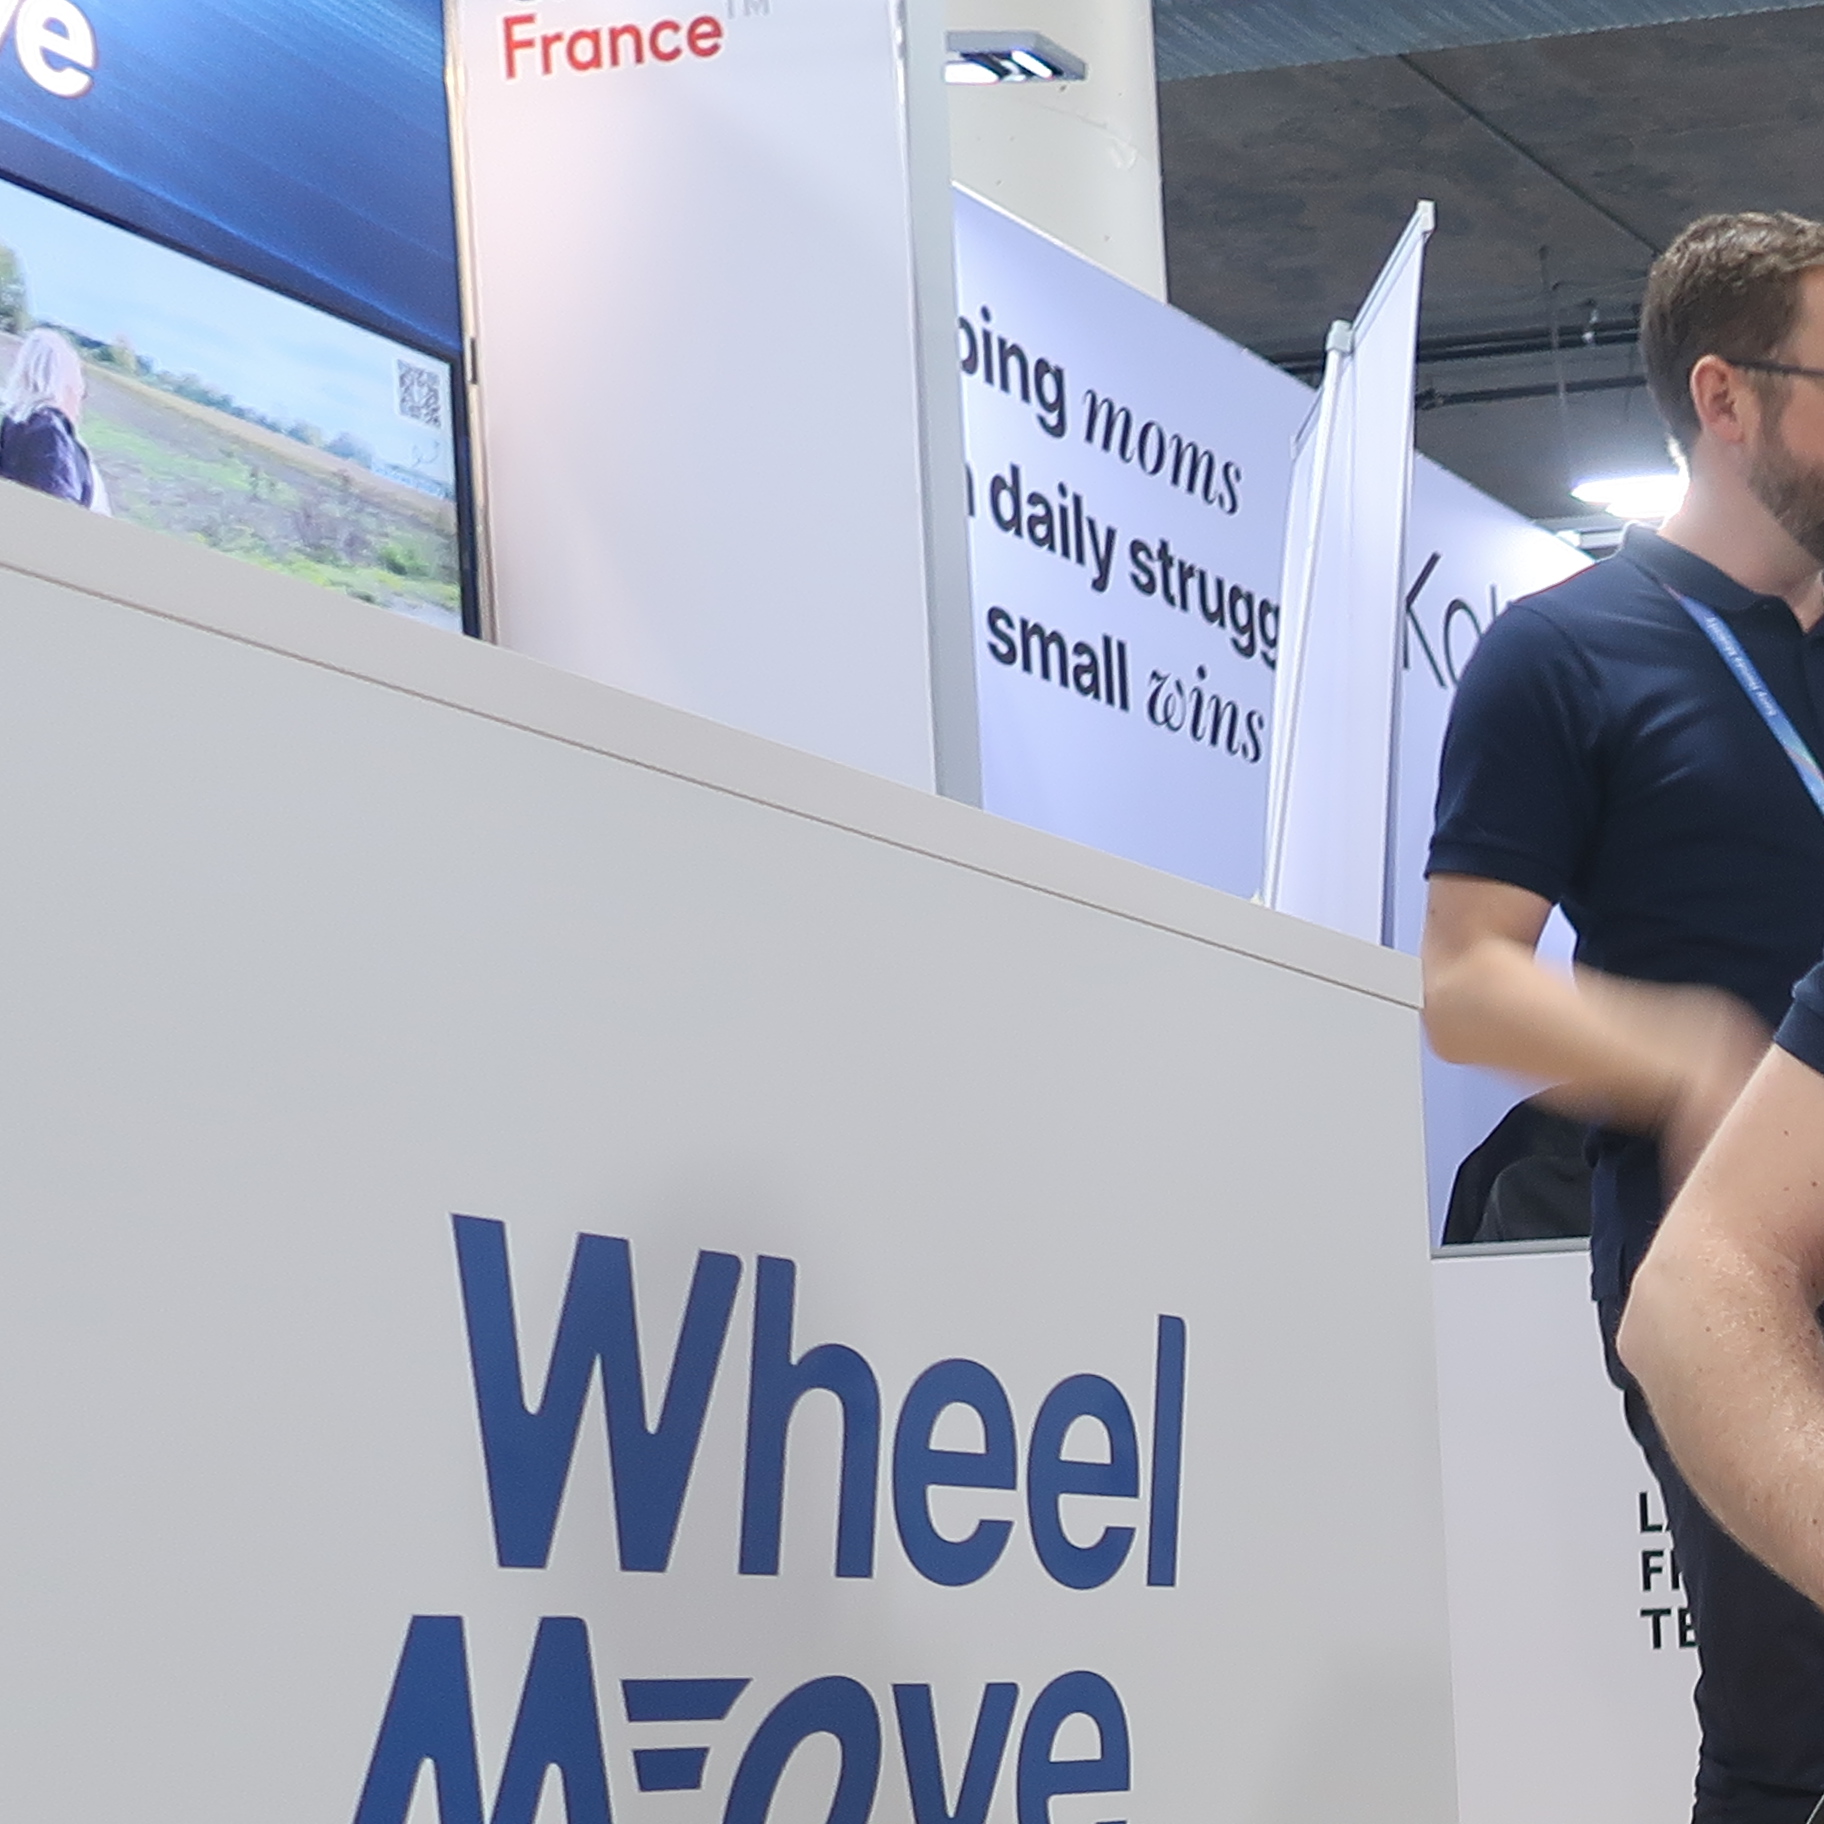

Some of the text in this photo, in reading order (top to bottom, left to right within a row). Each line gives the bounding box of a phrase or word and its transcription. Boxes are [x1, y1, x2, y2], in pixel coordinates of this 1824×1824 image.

[503, 13, 722, 79] France
[1082, 387, 1244, 516] moms
[989, 463, 1117, 594] daily
[985, 602, 1266, 764] small wins
[450, 1212, 1187, 1590] Wheel
